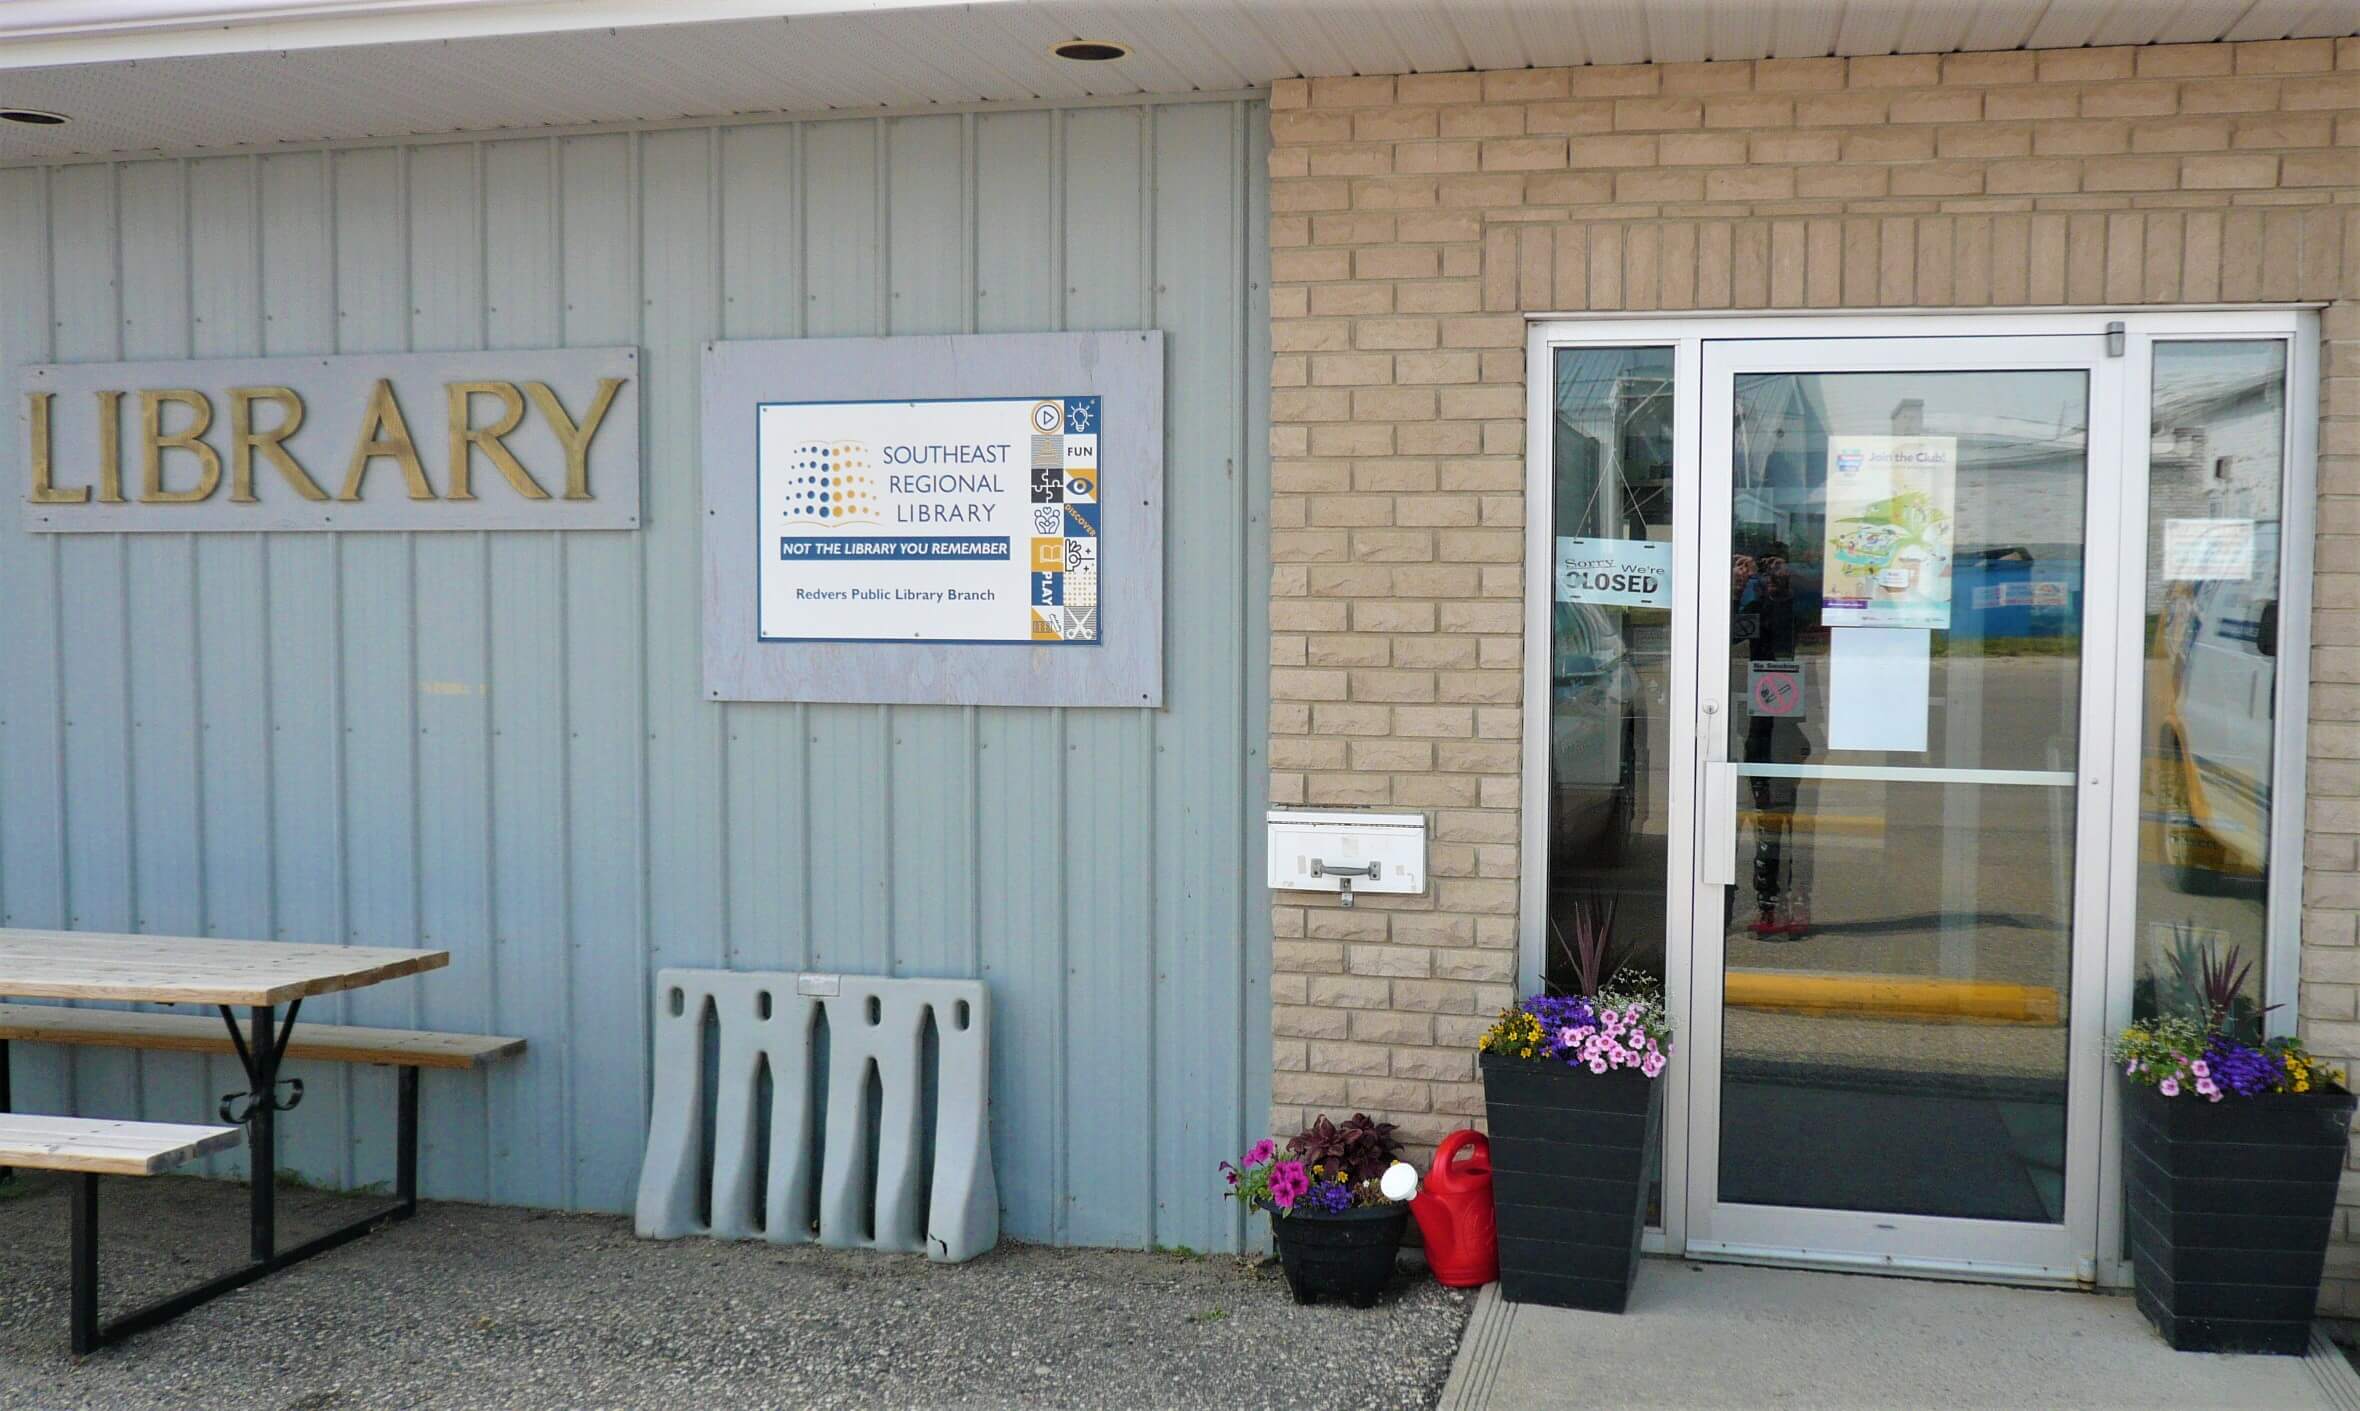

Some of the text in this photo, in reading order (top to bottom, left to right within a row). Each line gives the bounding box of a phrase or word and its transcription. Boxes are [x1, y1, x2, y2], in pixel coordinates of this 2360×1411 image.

[26, 378, 628, 503] LIBRARY
[883, 444, 1011, 464] SOUTHEAST
[1067, 447, 1093, 457] FUN
[1895, 451, 1914, 463] the
[890, 474, 1004, 493] REGIONAL
[898, 504, 996, 522] LIBRARY
[1064, 503, 1096, 537] DISCOVER
[783, 542, 1008, 555] NOT THE LIBRARY YOU REMEMBER
[1564, 559, 1665, 575] Sorry We're
[1042, 571, 1053, 606] PLAY
[1565, 571, 1658, 593] CLOSED
[796, 588, 995, 603] Redvers Public Library Branch
